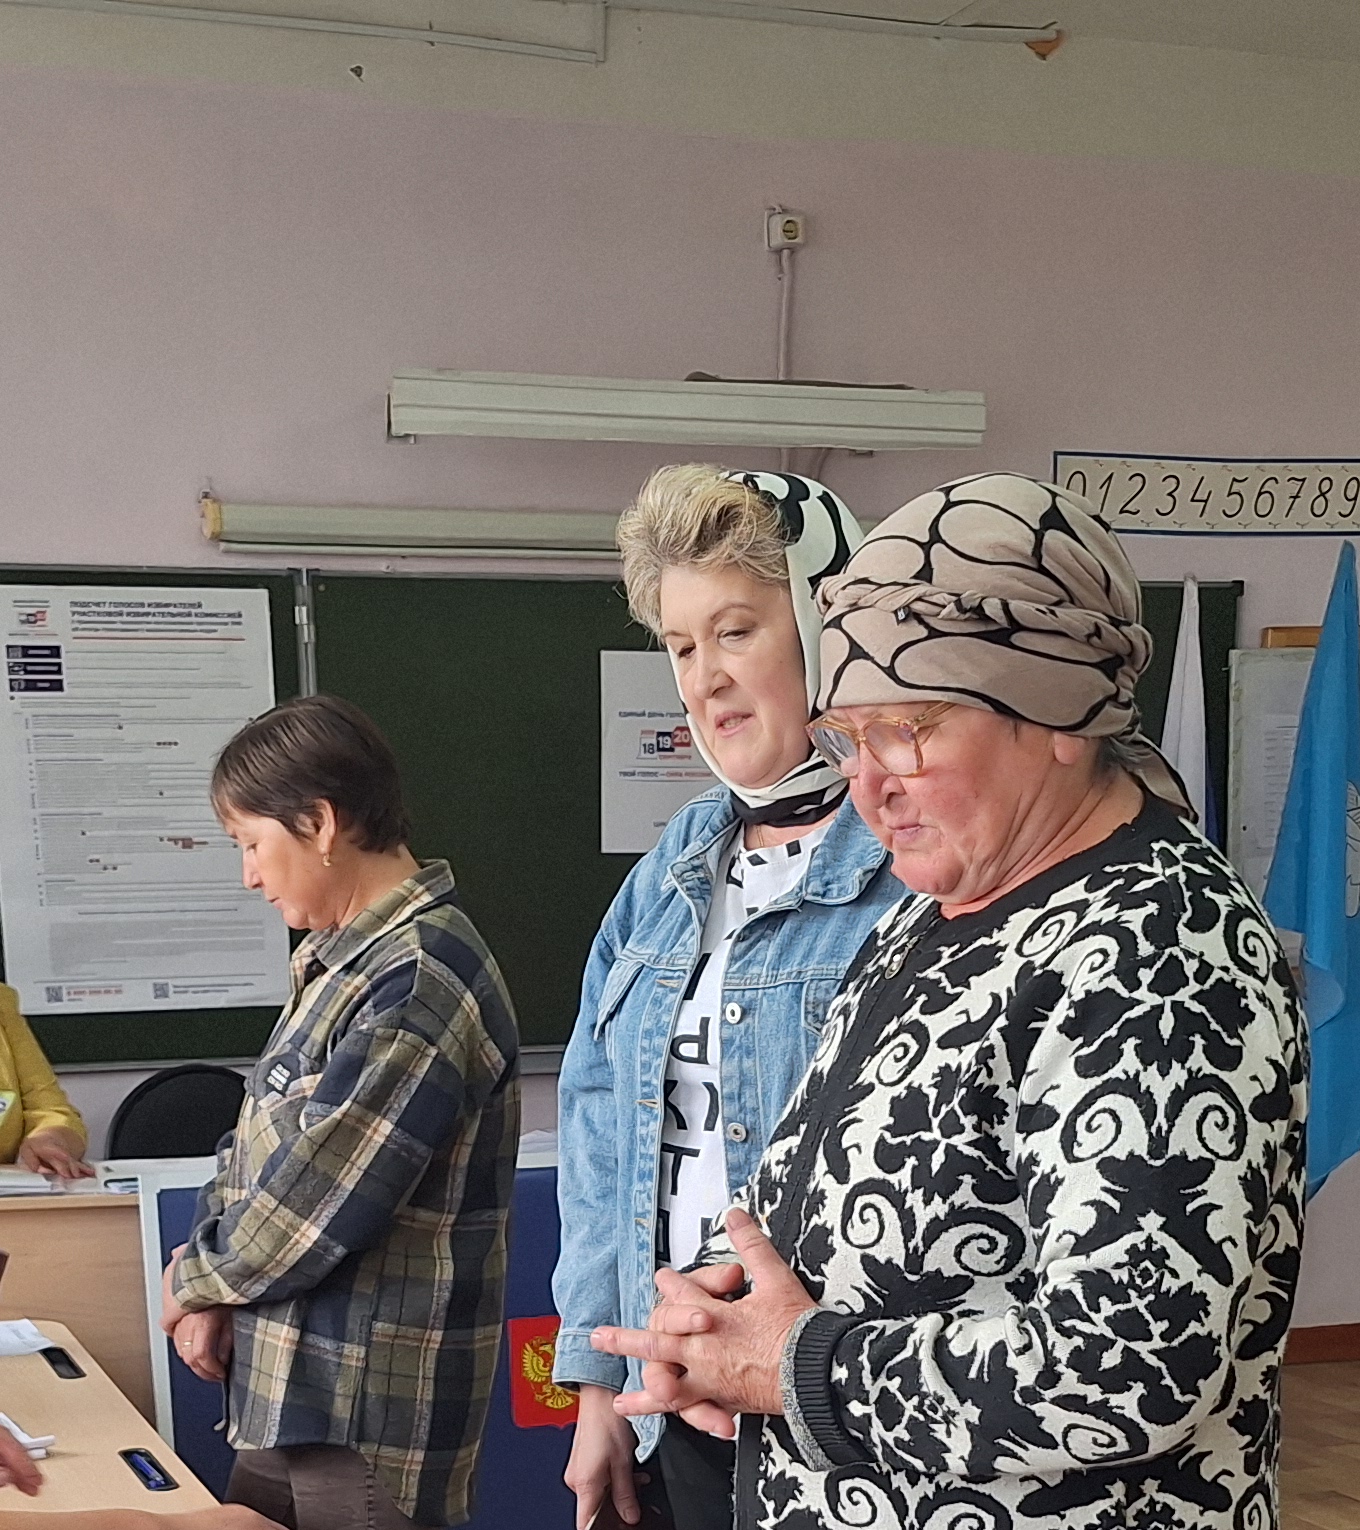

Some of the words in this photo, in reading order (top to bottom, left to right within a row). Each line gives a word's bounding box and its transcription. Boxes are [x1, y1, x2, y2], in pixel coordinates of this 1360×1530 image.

[642, 743, 656, 754] 18
[658, 736, 671, 748] 19
[673, 731, 689, 742] 20
